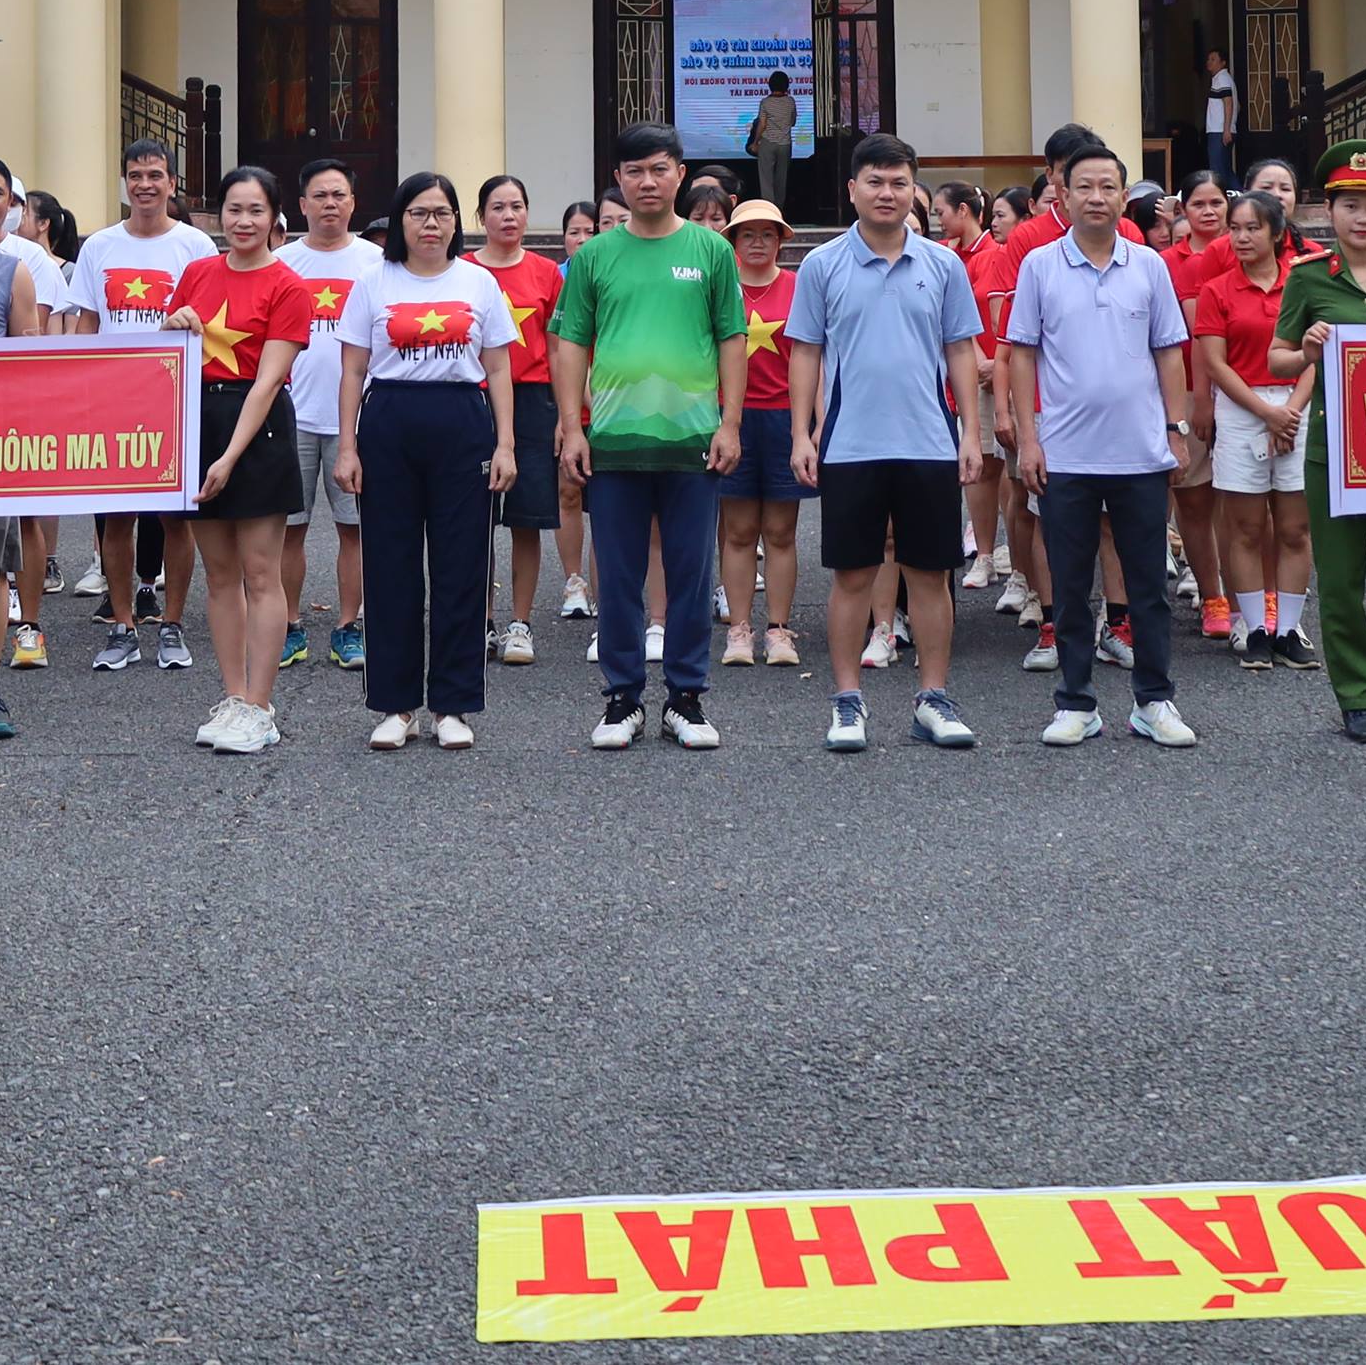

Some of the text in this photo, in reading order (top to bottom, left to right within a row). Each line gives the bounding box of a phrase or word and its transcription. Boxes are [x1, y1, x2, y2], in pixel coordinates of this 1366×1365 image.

[135, 305, 164, 323] NAM
[434, 337, 467, 361] NAM
[66, 433, 108, 471] MA
[116, 424, 164, 469] TÚY
[516, 1203, 1009, 1312] PHÁT
